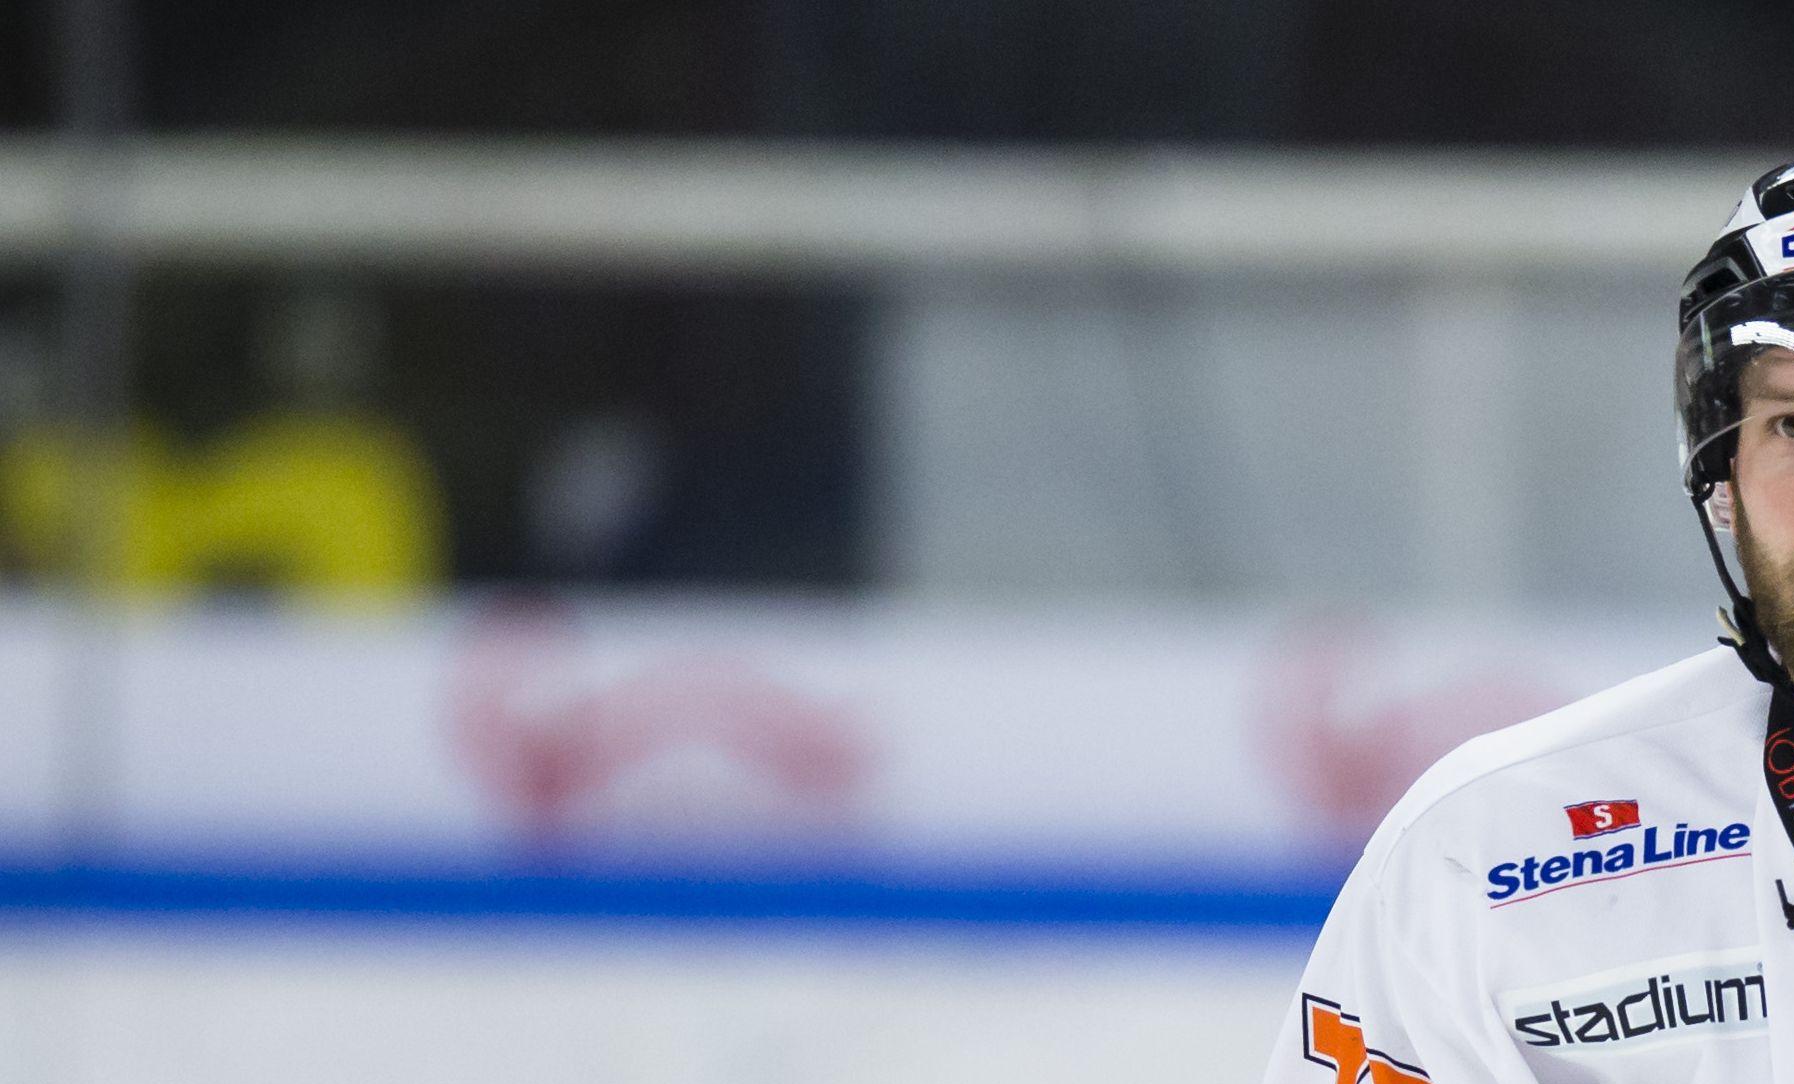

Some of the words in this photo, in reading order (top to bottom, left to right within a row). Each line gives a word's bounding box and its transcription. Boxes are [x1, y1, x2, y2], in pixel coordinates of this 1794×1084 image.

[1592, 804, 1614, 829] S
[1486, 842, 1636, 901] Stena
[1643, 822, 1751, 865] Line
[1514, 974, 1768, 1047] stadium
